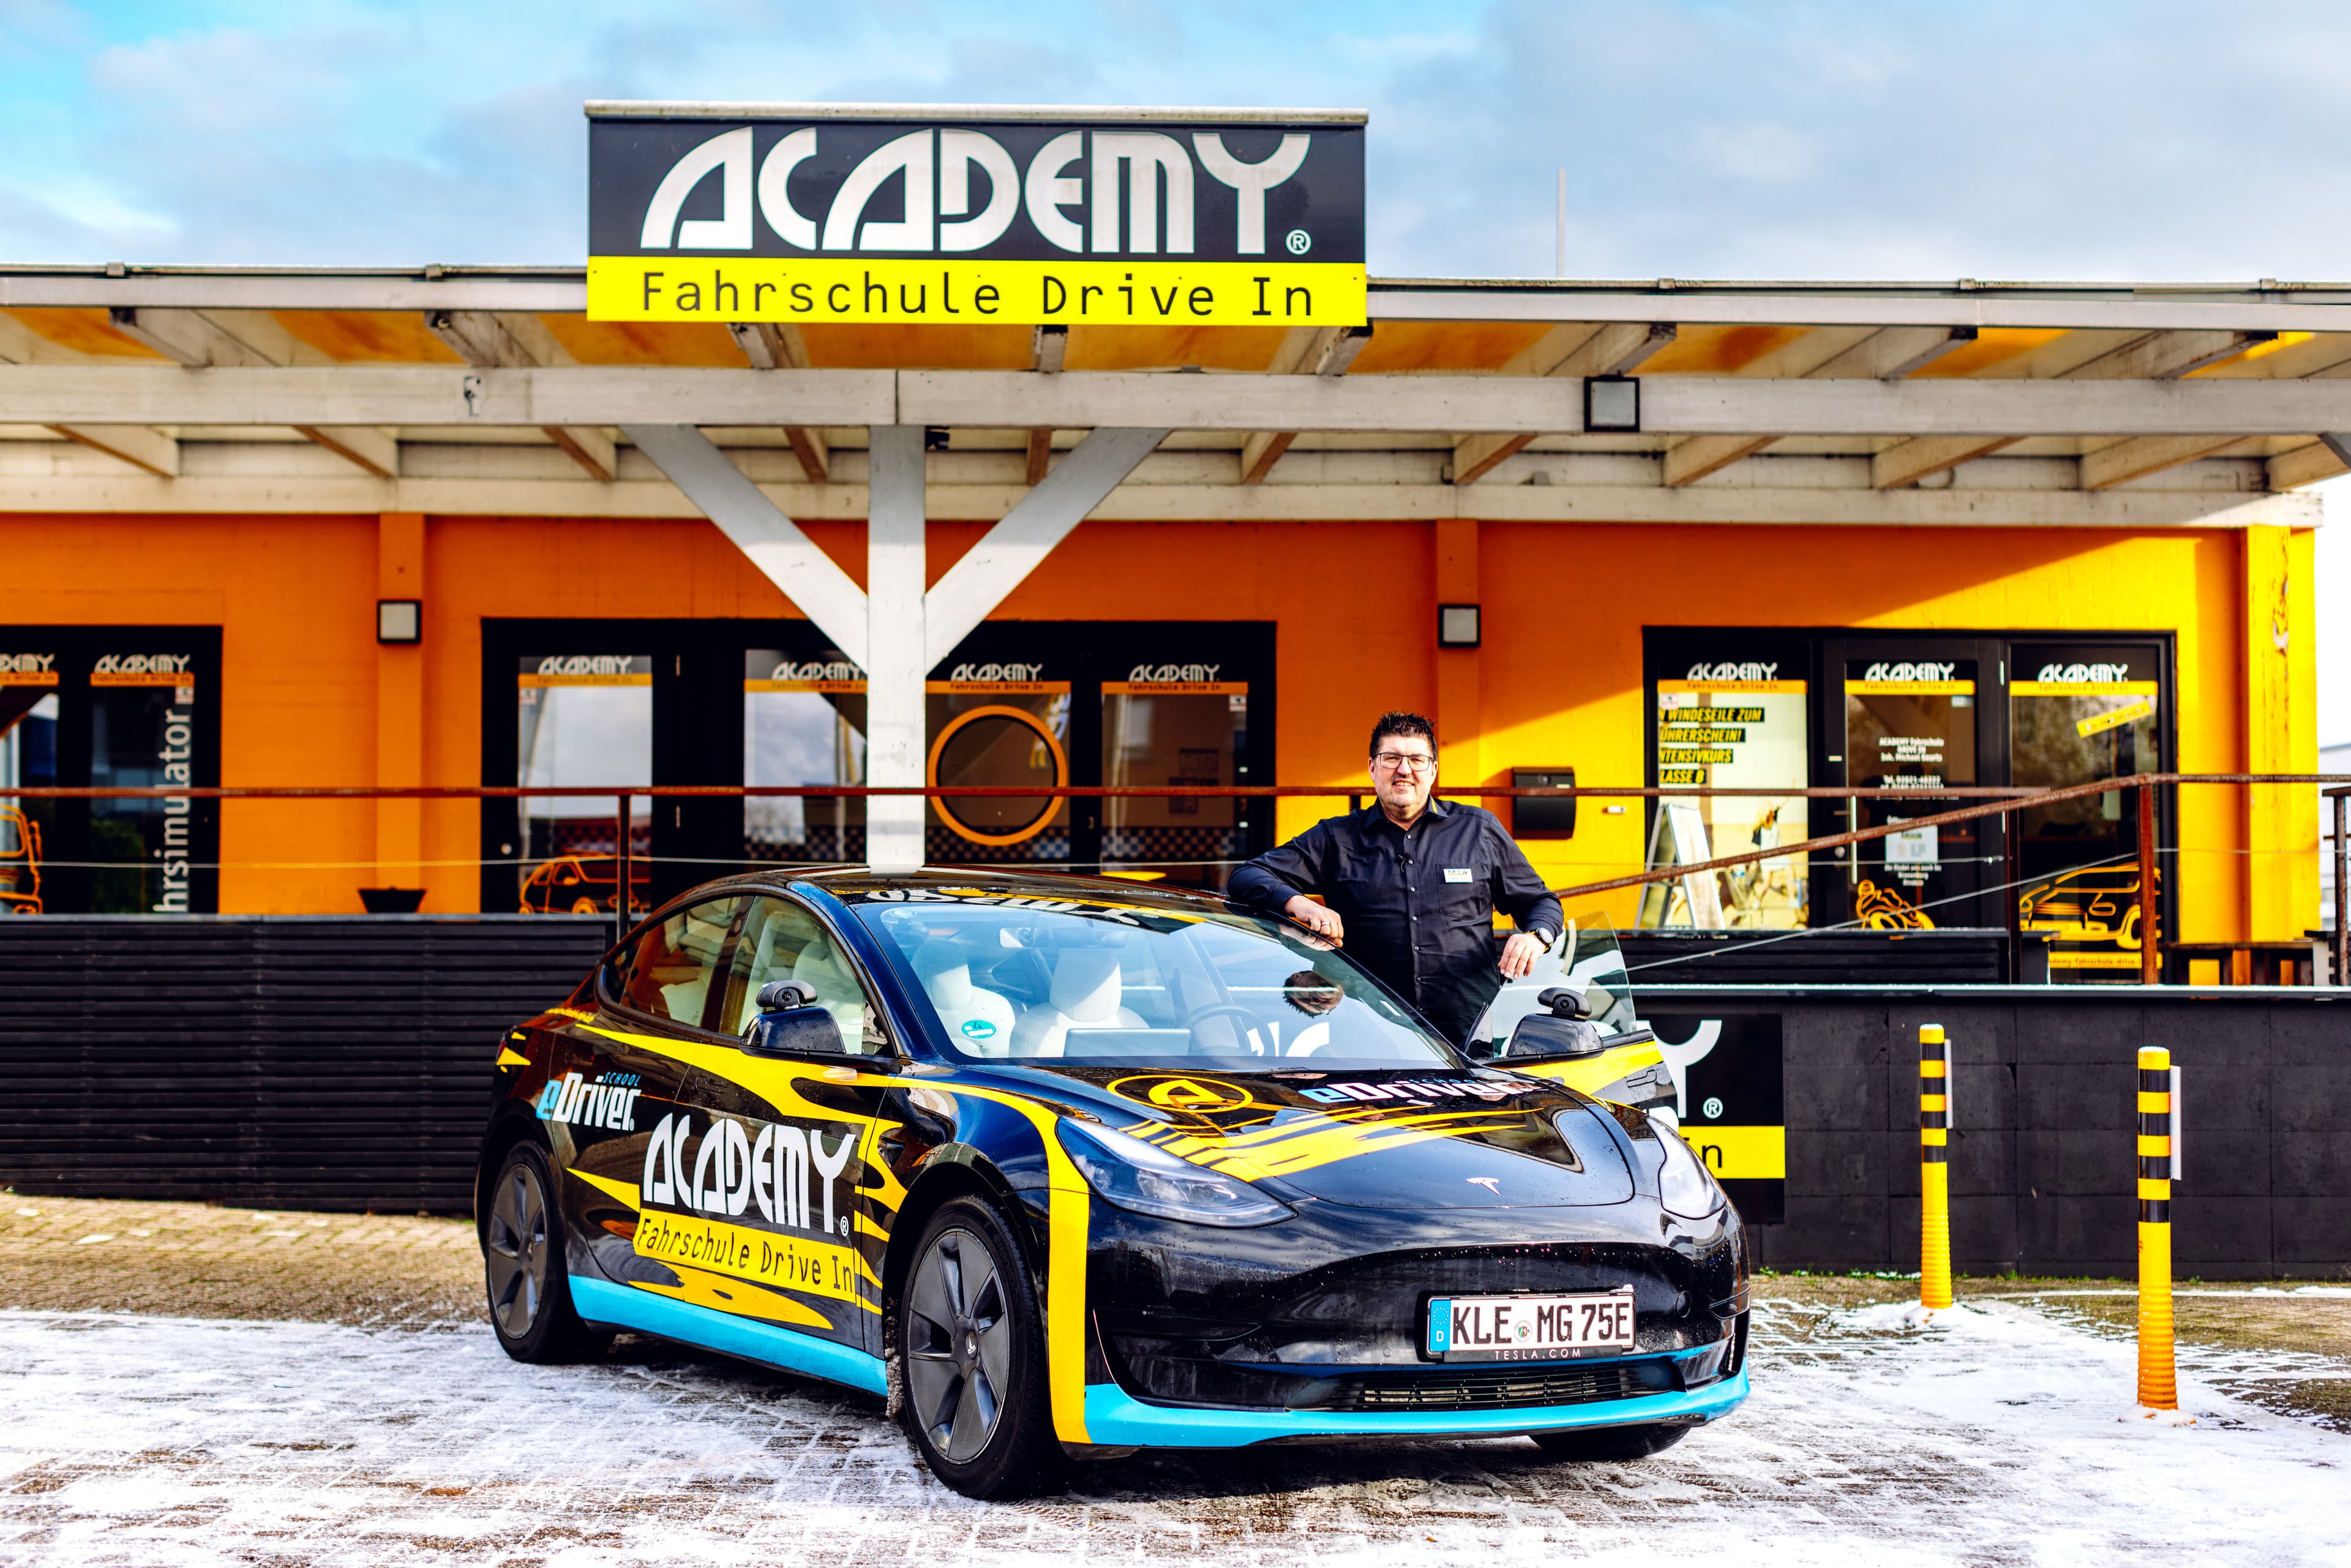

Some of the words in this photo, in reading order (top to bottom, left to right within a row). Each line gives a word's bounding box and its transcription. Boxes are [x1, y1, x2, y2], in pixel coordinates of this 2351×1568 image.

[643, 271, 1001, 315] Fahrschule
[1043, 276, 1215, 317] Drive
[1251, 280, 1313, 317] In
[1668, 708, 1735, 721] WINDESEILE
[1737, 708, 1763, 721] ZUM
[1660, 725, 1742, 743] ÜHRERSCHEIN!
[1659, 749, 1732, 763] NTENSIVKURS
[1660, 770, 1693, 784] LASSE
[603, 1071, 641, 1086] SCHOOL
[637, 1218, 750, 1269] Fahrschule
[761, 1244, 822, 1285] Drive
[831, 1255, 854, 1293] In
[1436, 1330, 1444, 1342] D
[1452, 1306, 1512, 1345] KLE
[1537, 1305, 1573, 1343] MG
[1581, 1302, 1630, 1341] 75E
[1494, 1348, 1581, 1361] TESLA.COM
